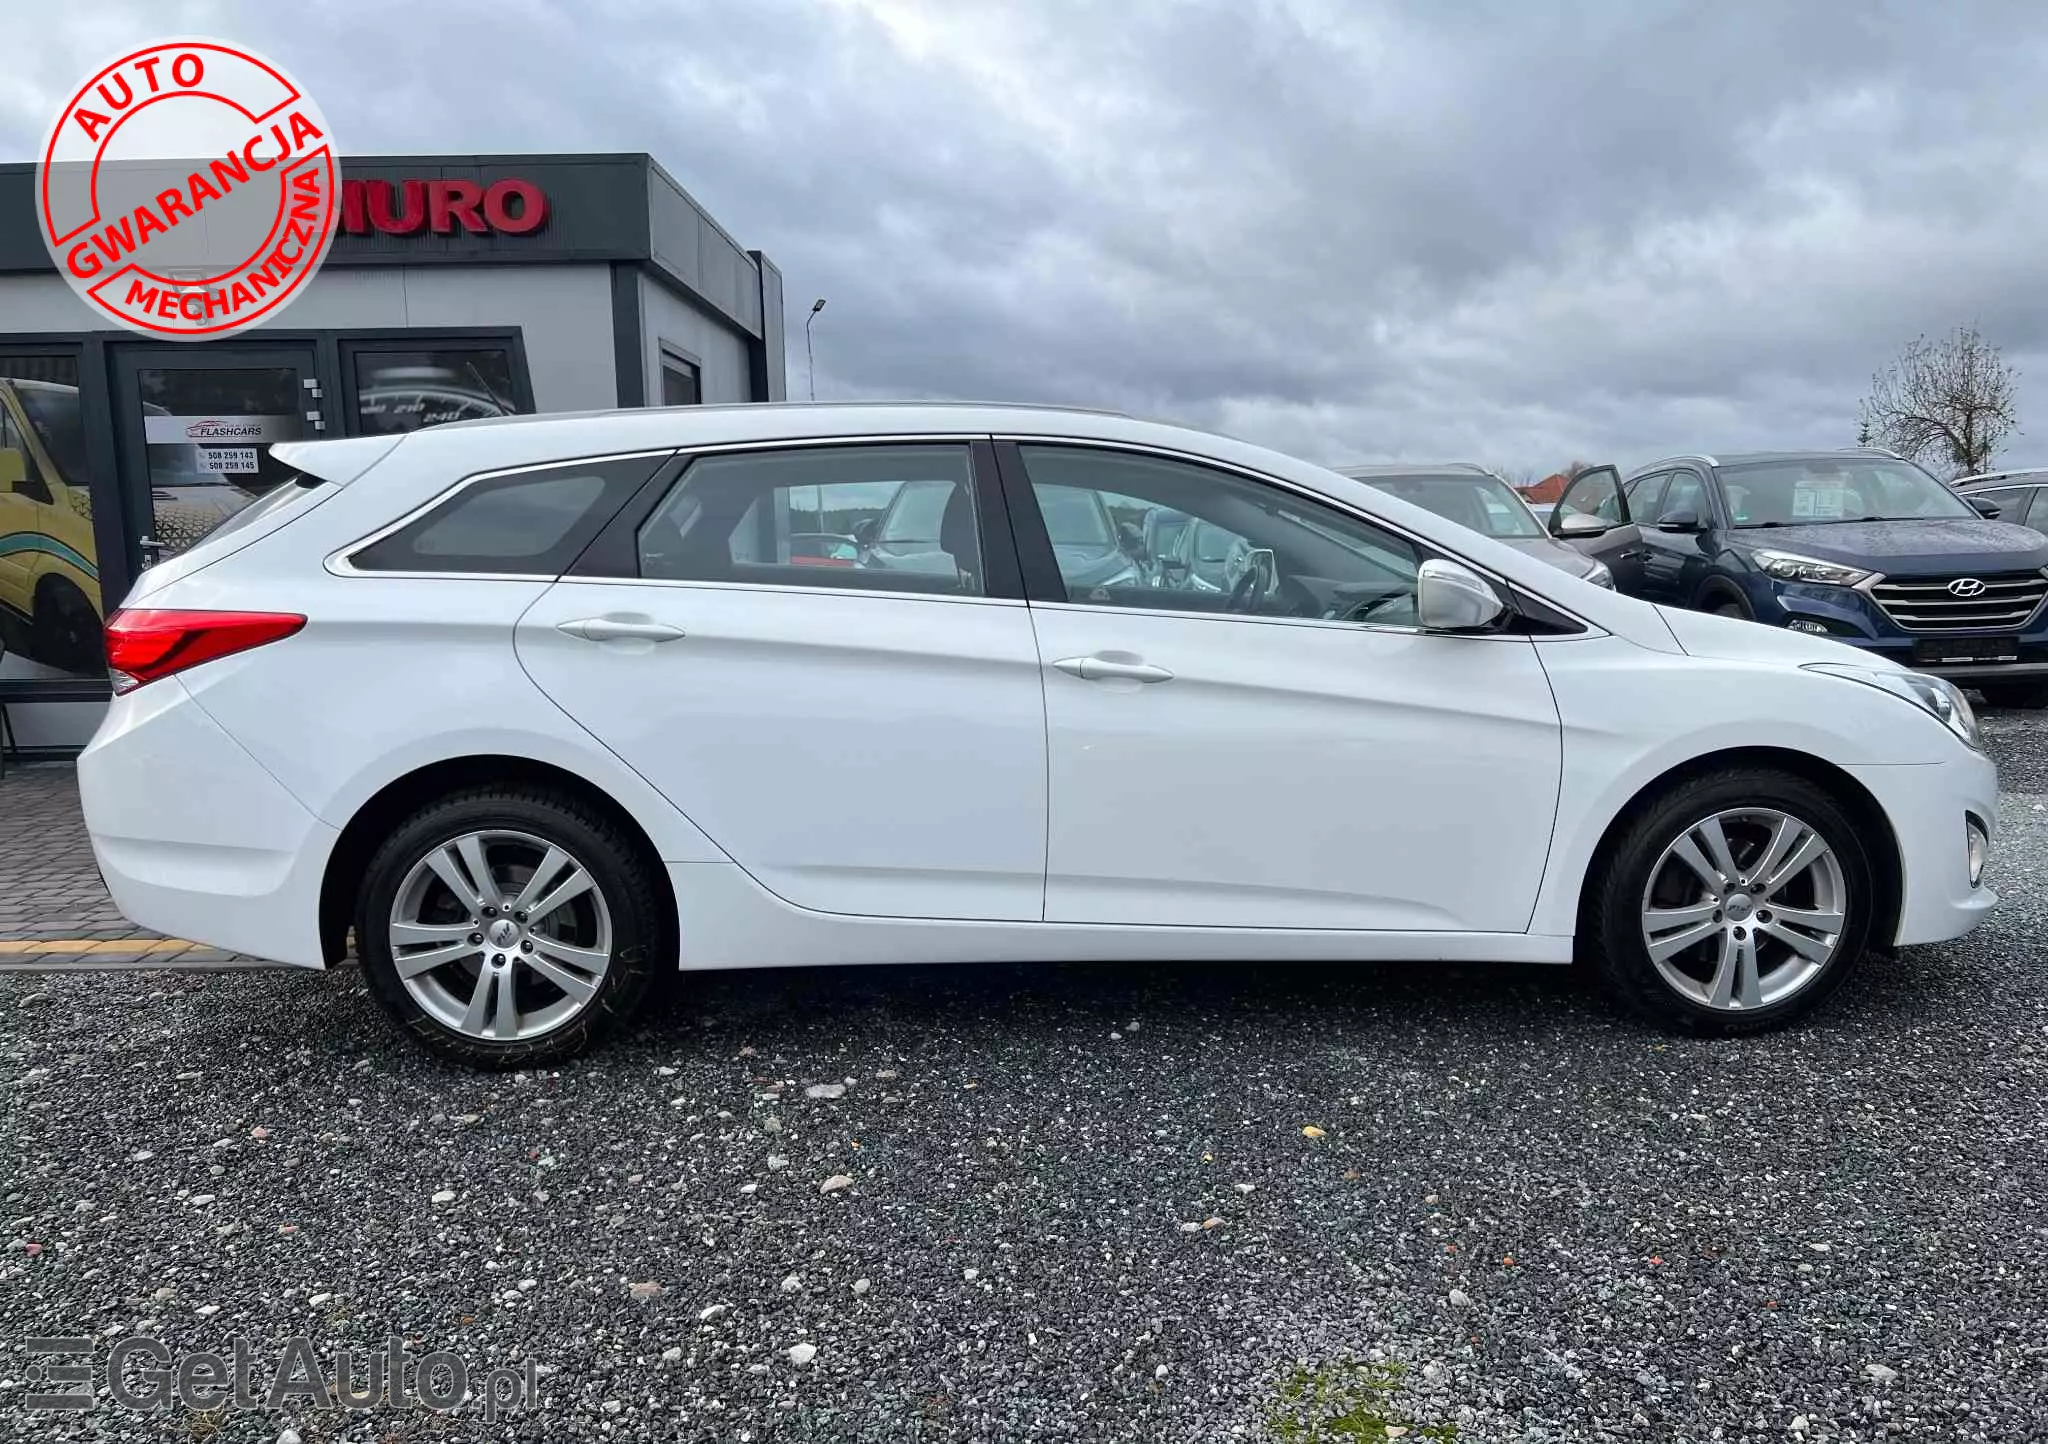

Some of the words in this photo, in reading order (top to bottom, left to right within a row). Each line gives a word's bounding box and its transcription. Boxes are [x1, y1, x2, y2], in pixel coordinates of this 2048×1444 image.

[200, 427, 262, 436] FLASHCARS
[240, 450, 254, 460] 143
[240, 461, 255, 470] 145
